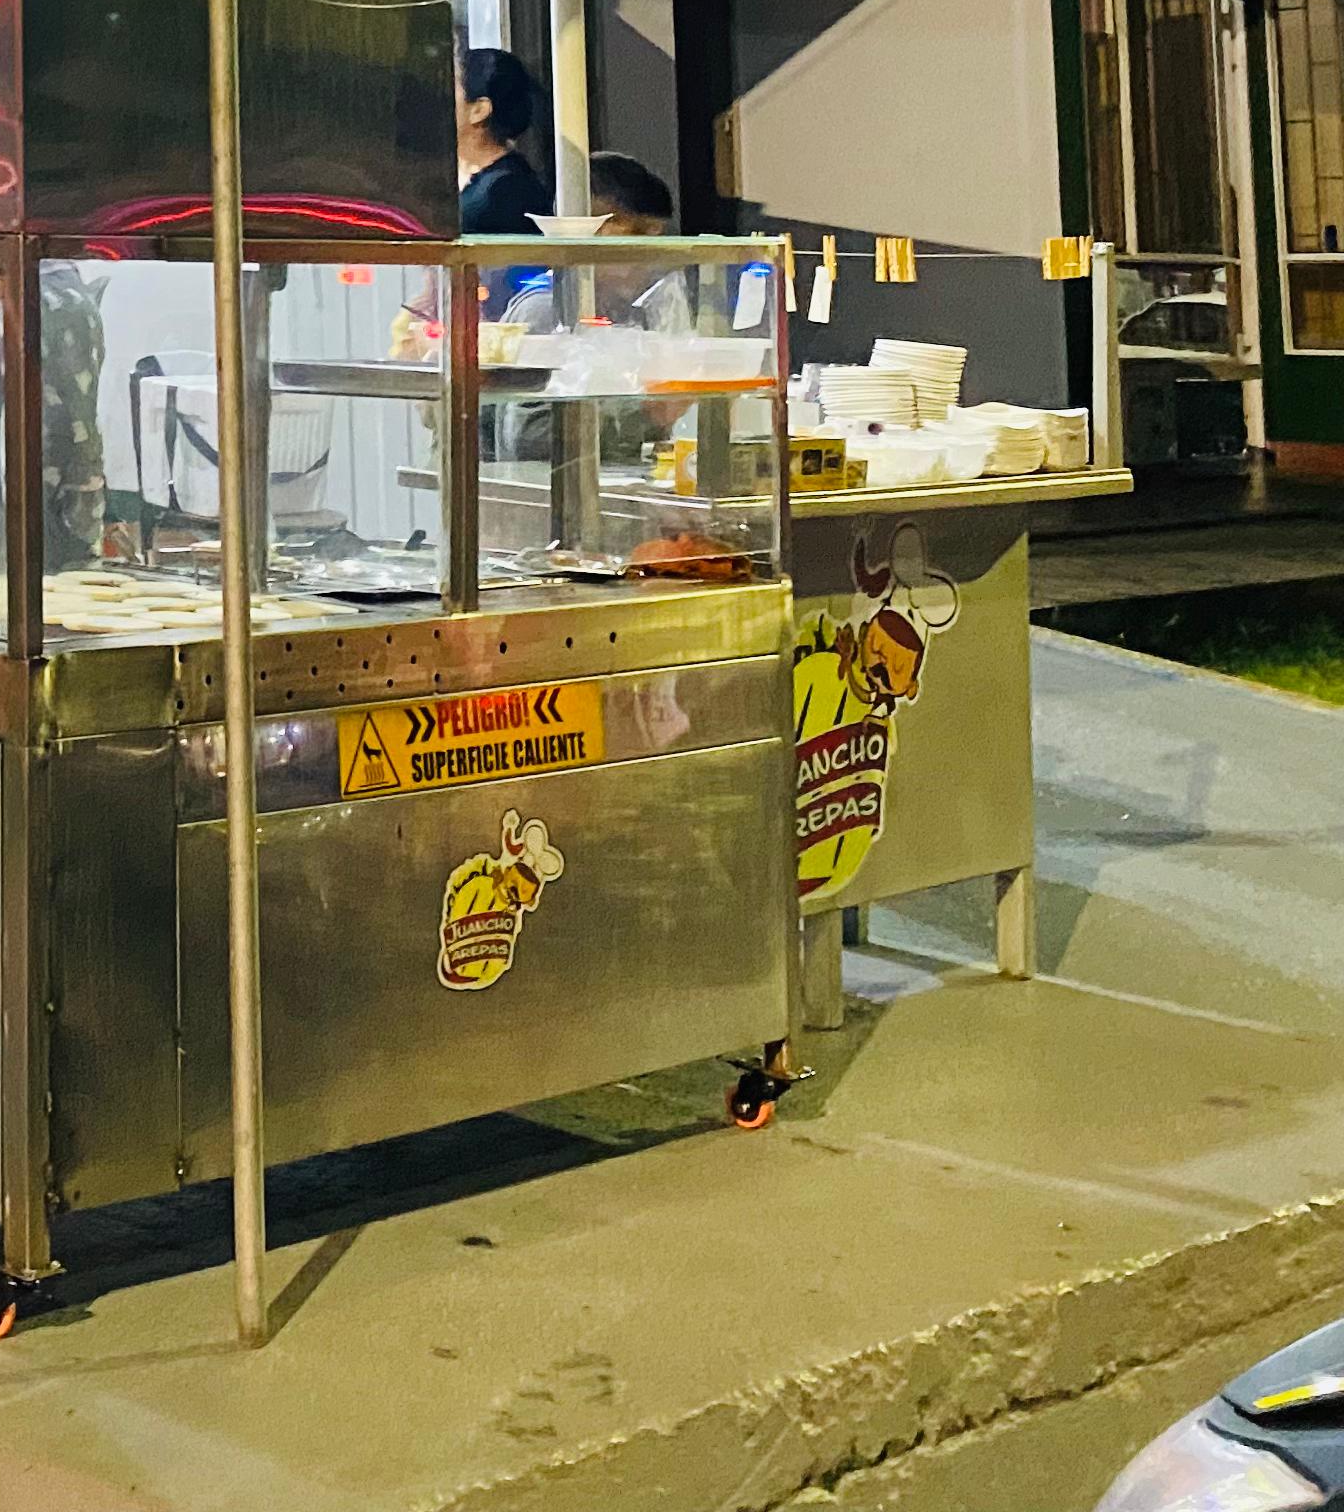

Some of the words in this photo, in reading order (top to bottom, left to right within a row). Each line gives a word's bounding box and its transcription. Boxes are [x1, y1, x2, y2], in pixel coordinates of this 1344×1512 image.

[435, 691, 530, 738] PELIGRO!
[412, 740, 510, 783] SUPERFICIE
[513, 731, 587, 769] CALIENTE
[446, 917, 514, 944] JUANCHO
[452, 943, 509, 962] AREPAS
